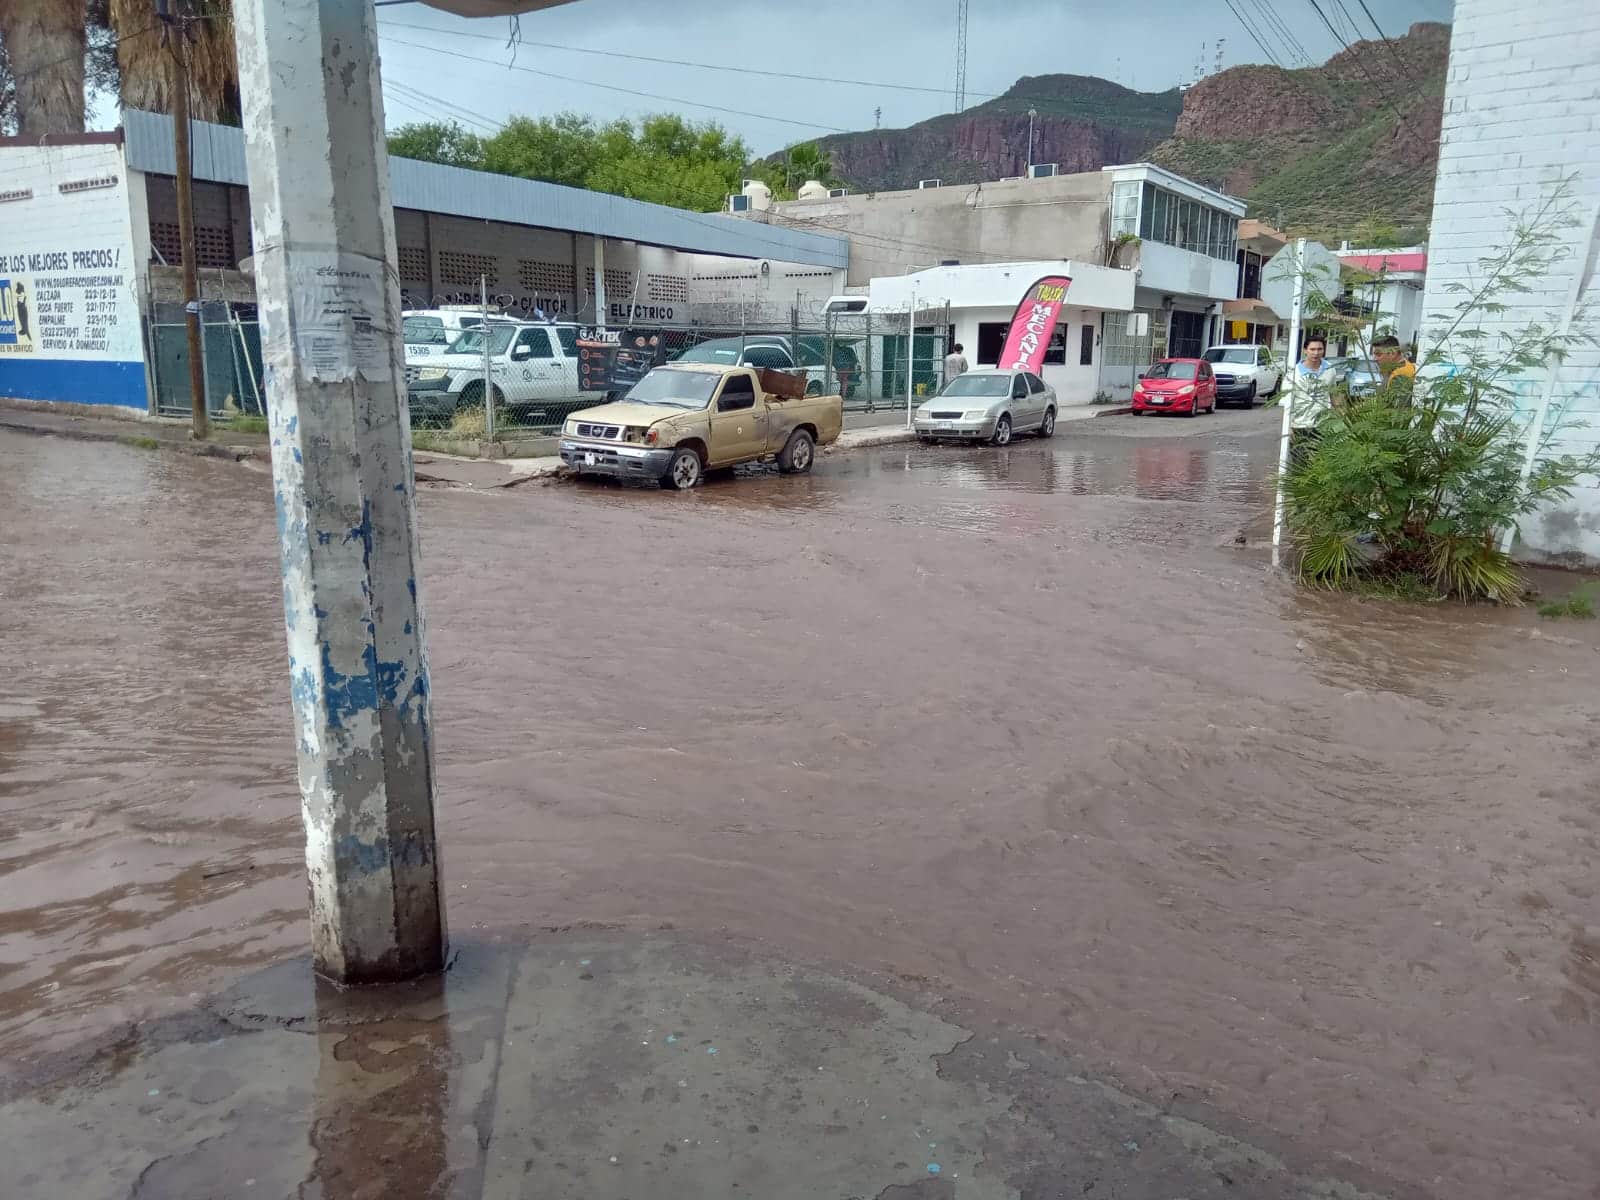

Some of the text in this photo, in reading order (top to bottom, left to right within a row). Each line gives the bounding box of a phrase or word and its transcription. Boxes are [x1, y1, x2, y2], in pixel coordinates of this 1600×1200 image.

[9, 254, 26, 273] LOS
[28, 251, 69, 272] MEJORES
[36, 290, 61, 301] CALZADA
[54, 302, 73, 313] FUERTE
[521, 297, 567, 313] CLUTCH
[611, 303, 674, 319] ELECTRICO
[39, 314, 66, 325] EMPALME
[42, 339, 67, 350] SERVICIO
[69, 339, 74, 350] A
